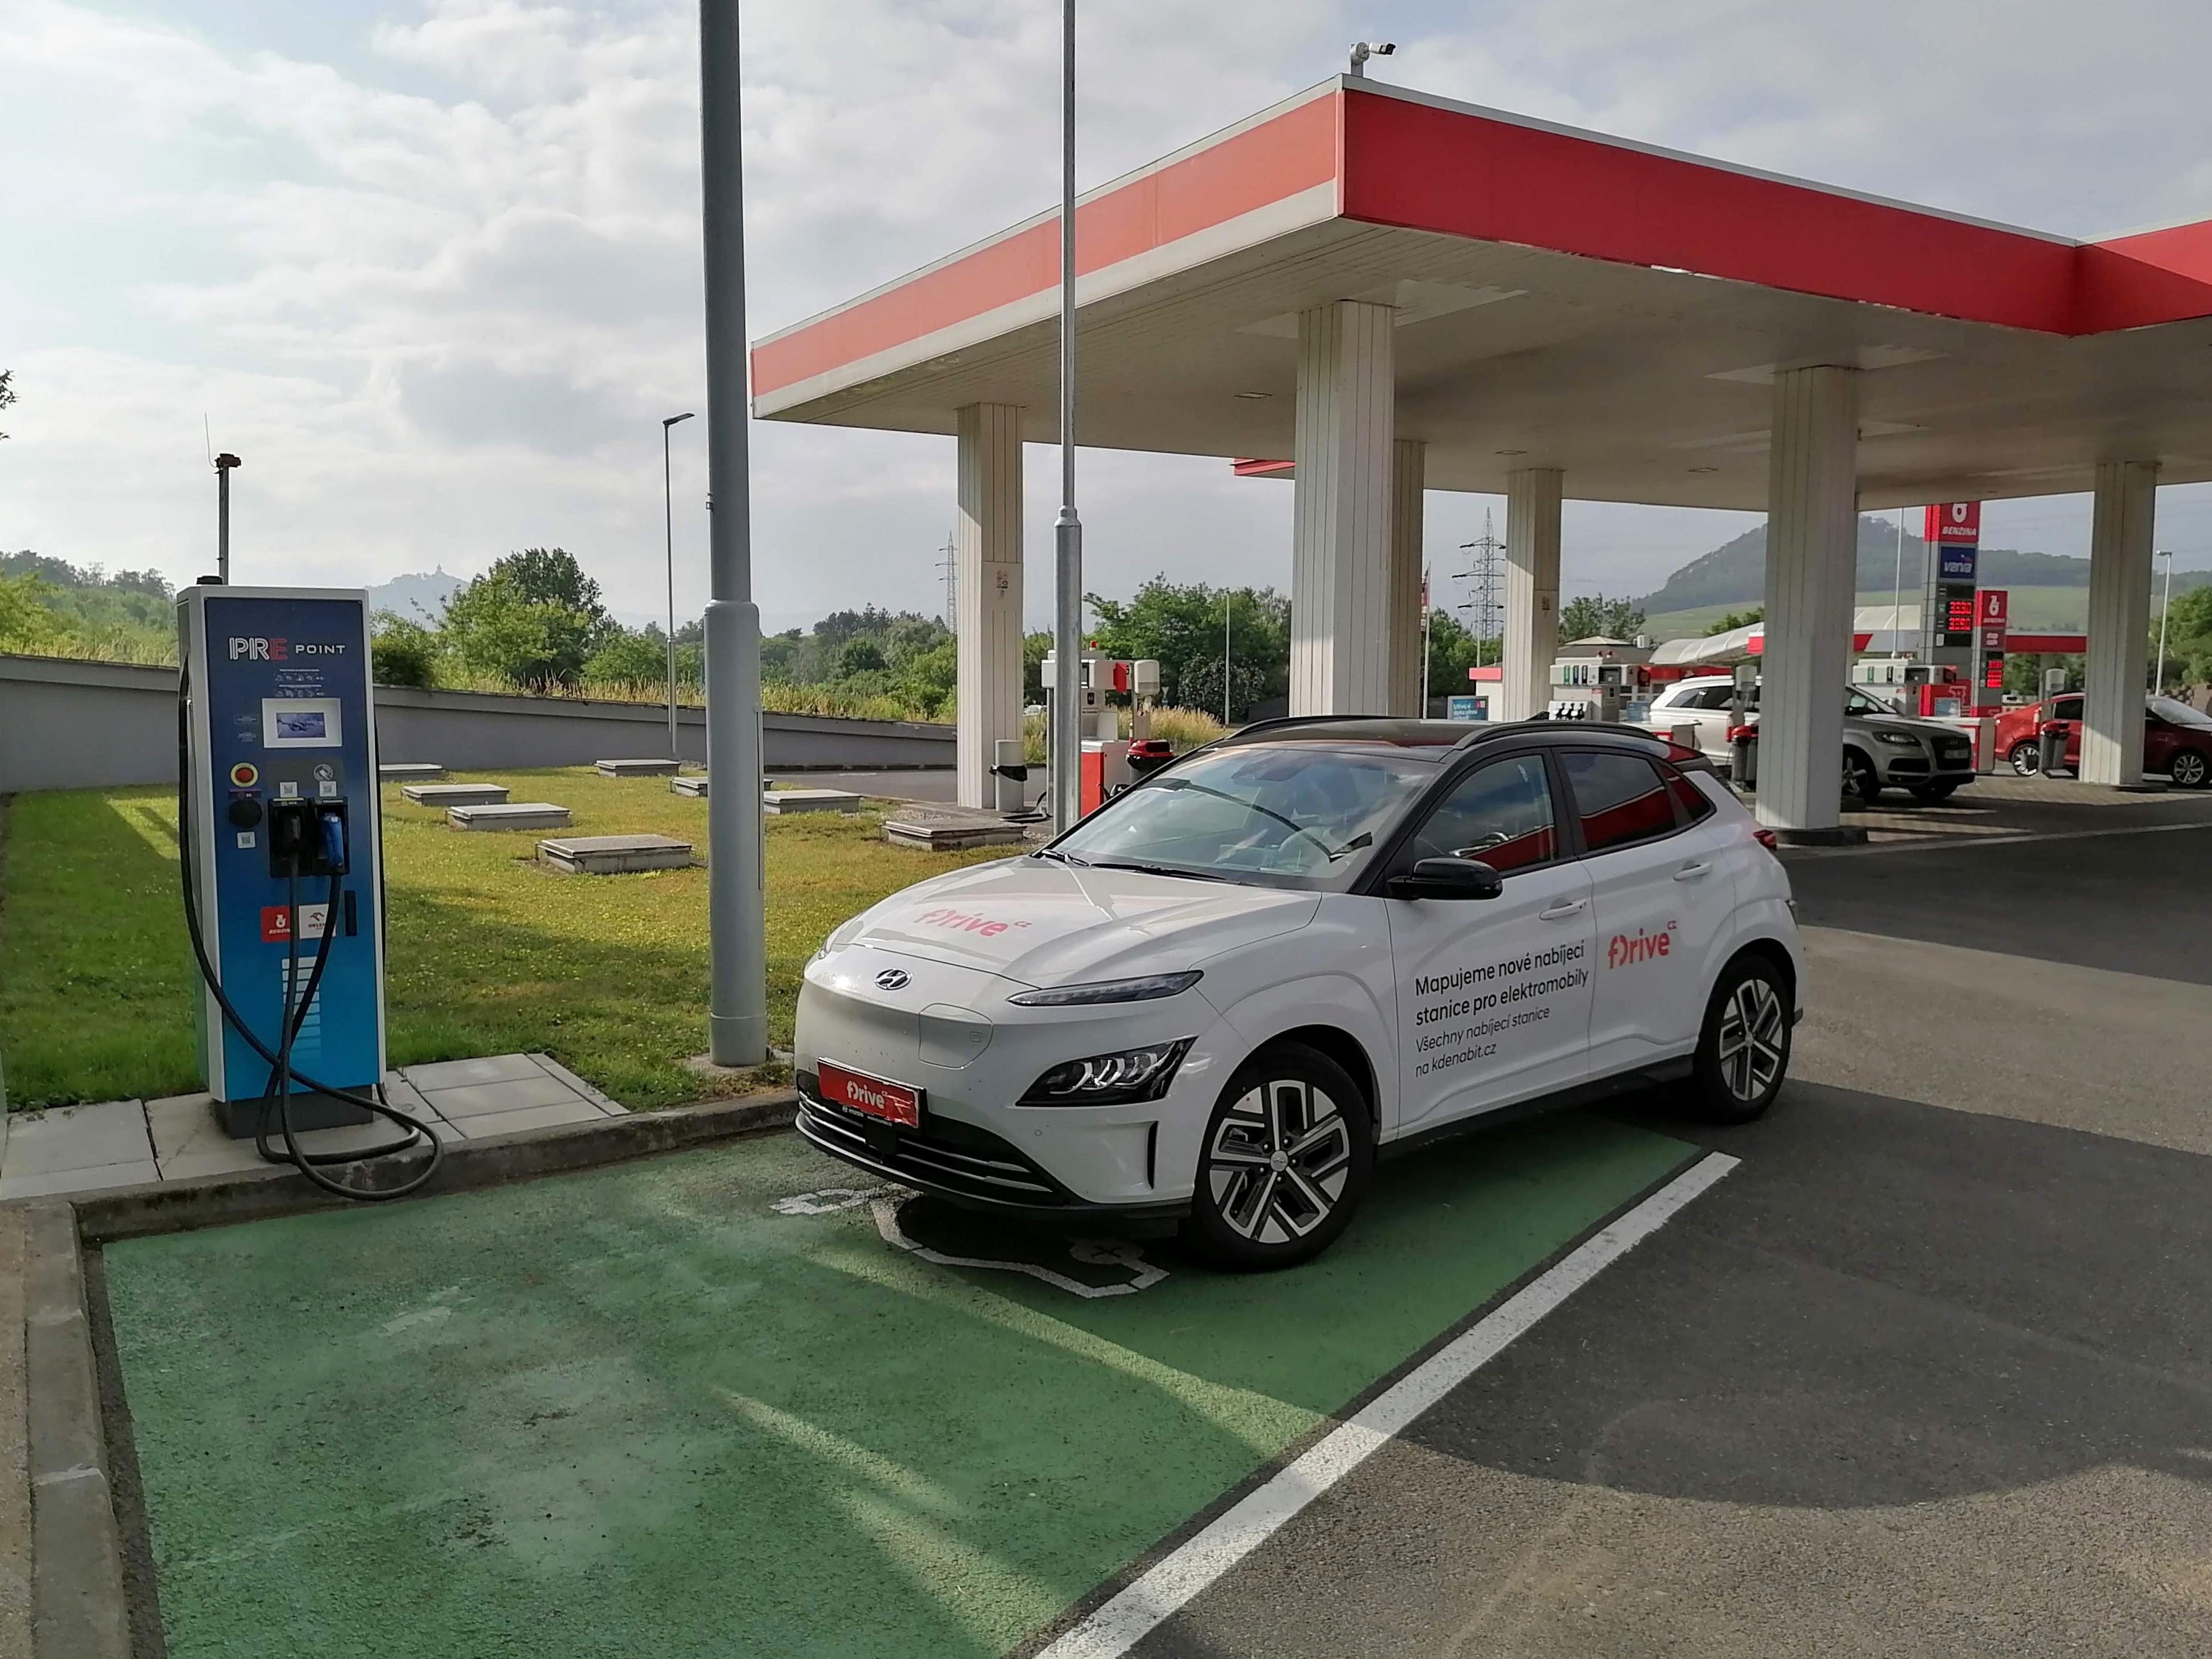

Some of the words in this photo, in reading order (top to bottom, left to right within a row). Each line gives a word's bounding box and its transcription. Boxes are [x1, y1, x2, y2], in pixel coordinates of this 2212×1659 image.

[229, 637, 288, 660] PRE
[295, 644, 346, 655] POINT
[1415, 965, 1495, 996] Mapujeme
[1498, 952, 1532, 977] nové
[1534, 939, 1584, 968] nabíjecí
[1416, 999, 1470, 1026] stanice
[1473, 993, 1497, 1016] pro
[1500, 968, 1589, 1004] elektromobily
[1416, 1030, 1464, 1053] Všechny
[1466, 1014, 1510, 1036] nabíjecí
[1512, 1007, 1550, 1027] stanice
[1416, 1061, 1429, 1078] na
[1431, 1043, 1497, 1072] kdenabit.cz
